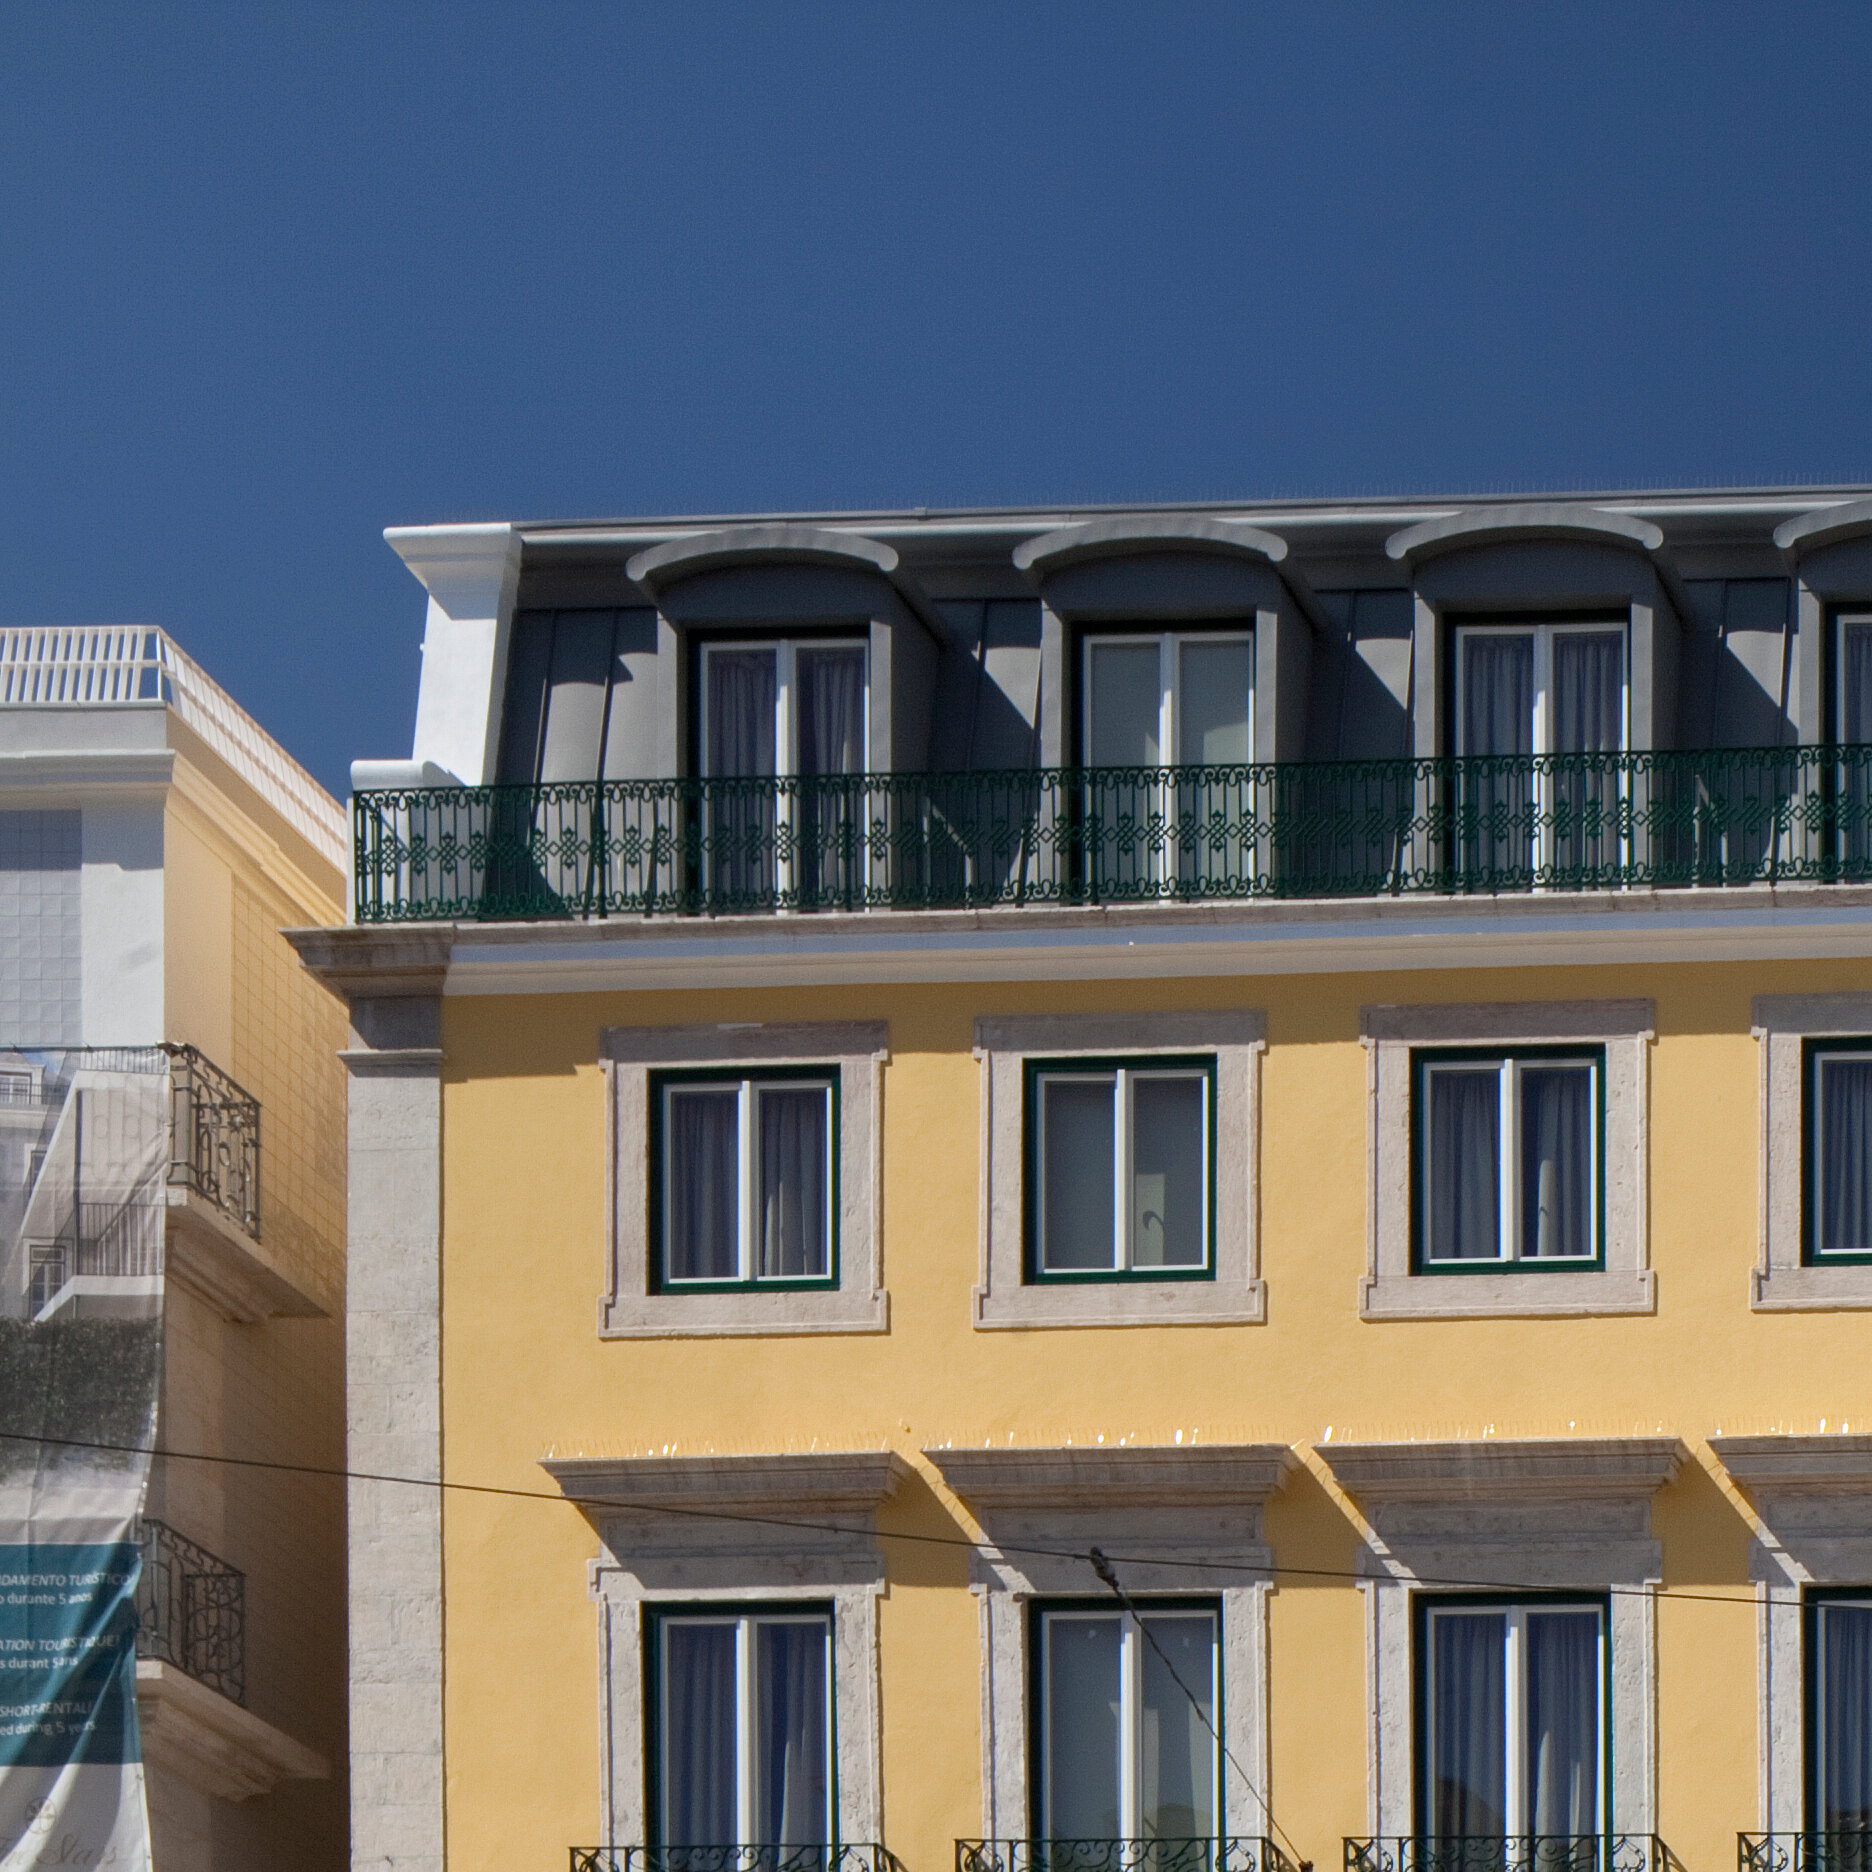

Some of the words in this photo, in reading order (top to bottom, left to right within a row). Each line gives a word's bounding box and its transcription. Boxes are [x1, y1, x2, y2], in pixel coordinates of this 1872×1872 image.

[0, 1574, 66, 1586] DAMENTO
[8, 1592, 55, 1605] durante
[8, 1657, 49, 1668] durant
